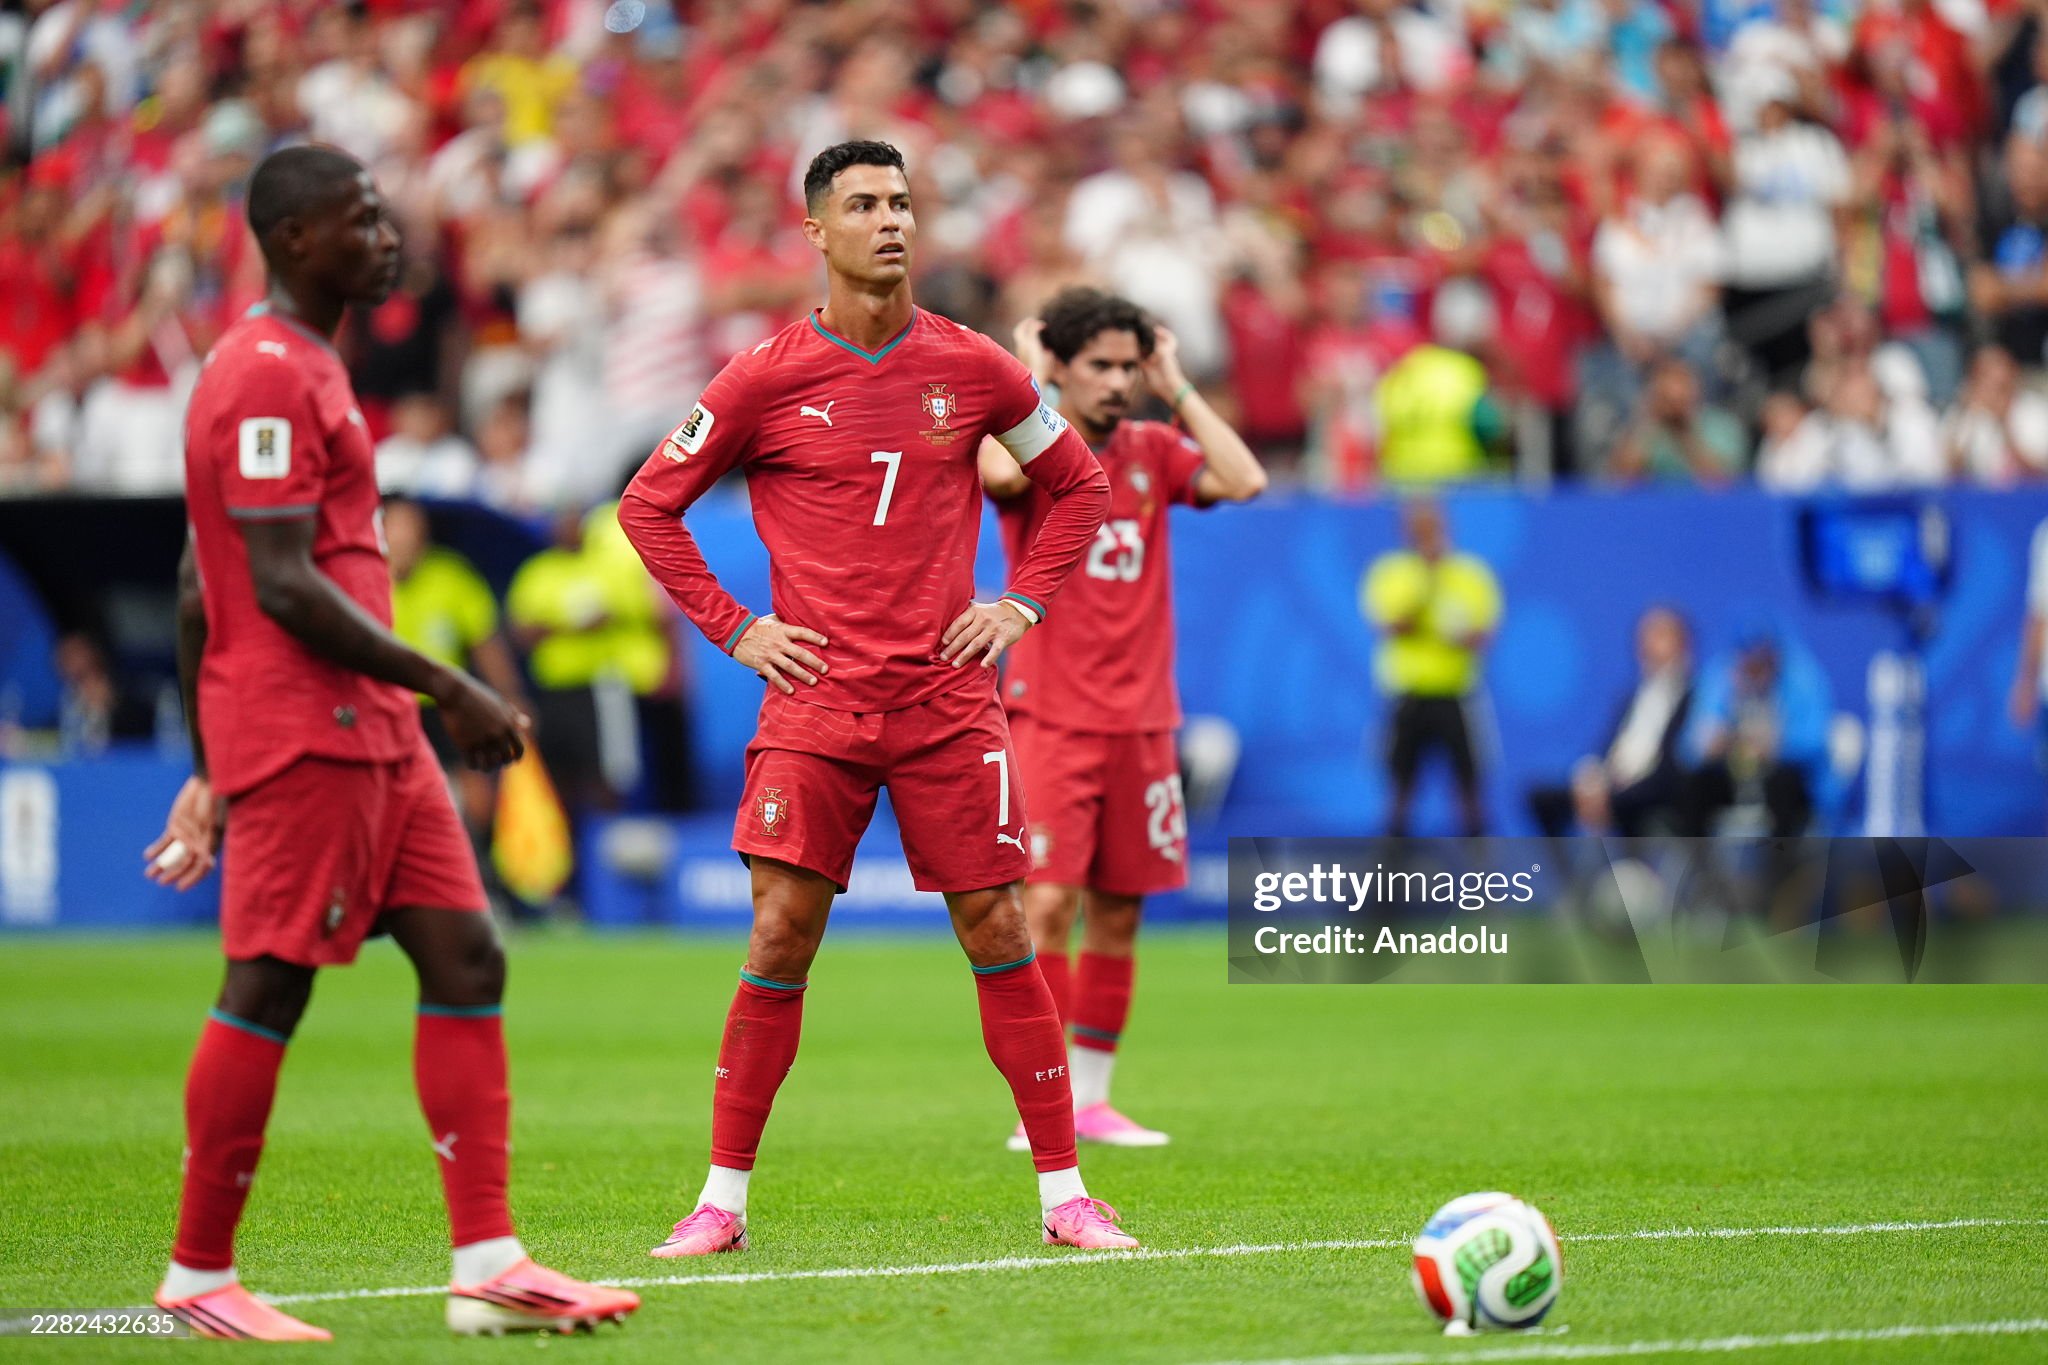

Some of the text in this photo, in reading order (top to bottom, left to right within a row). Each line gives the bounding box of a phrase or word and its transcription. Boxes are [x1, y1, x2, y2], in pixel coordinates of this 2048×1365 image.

[870, 451, 903, 526] 7
[1086, 519, 1145, 582] 23
[982, 748, 1009, 826] 7
